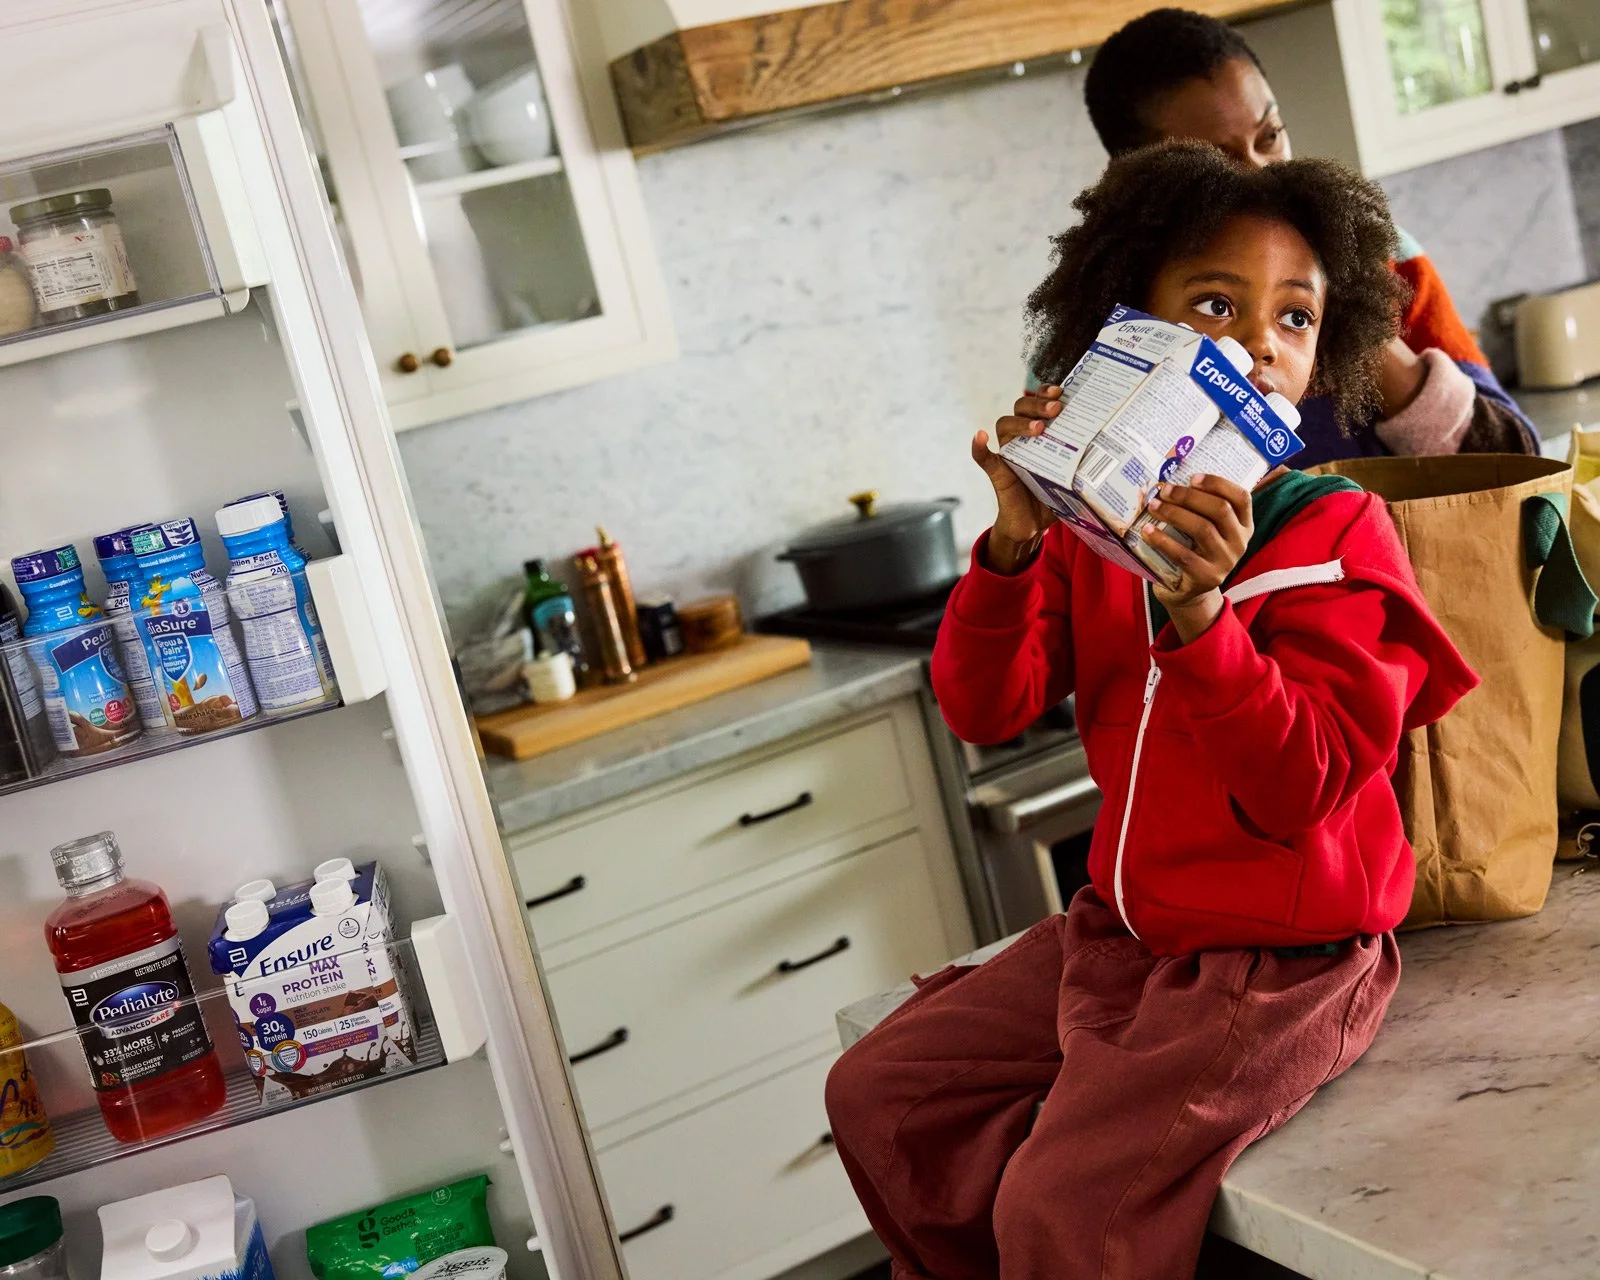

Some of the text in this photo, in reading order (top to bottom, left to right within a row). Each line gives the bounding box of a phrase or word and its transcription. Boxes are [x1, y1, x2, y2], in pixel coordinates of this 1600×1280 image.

[1118, 321, 1155, 334] Ensure
[1195, 357, 1250, 403] Ensure
[1248, 397, 1264, 414] MAX
[1244, 404, 1271, 434] PROTEIN
[253, 551, 278, 563] Facts
[270, 565, 288, 576] 240
[114, 597, 129, 608] 240
[109, 702, 118, 711] 27
[193, 708, 215, 718] shake
[260, 933, 335, 977] Ensure
[134, 961, 162, 977] ELECTROLYTE
[308, 955, 341, 975] MAX
[282, 970, 344, 995] PROTEIN
[286, 981, 347, 1004] nutrition shake
[98, 985, 175, 1021] Pedialyte
[256, 1003, 273, 1015] Sugar
[261, 1020, 285, 1035] 30g
[339, 1019, 351, 1031] 25
[263, 1032, 288, 1045] Protein
[302, 1027, 333, 1040] 150 Calories
[103, 1036, 153, 1059] 33% MORE
[120, 1055, 164, 1074] CHILLED CHERRY
[121, 1062, 162, 1079] POMEGRANATE
[435, 1188, 445, 1198] 12
[382, 1218, 420, 1236] Gather
